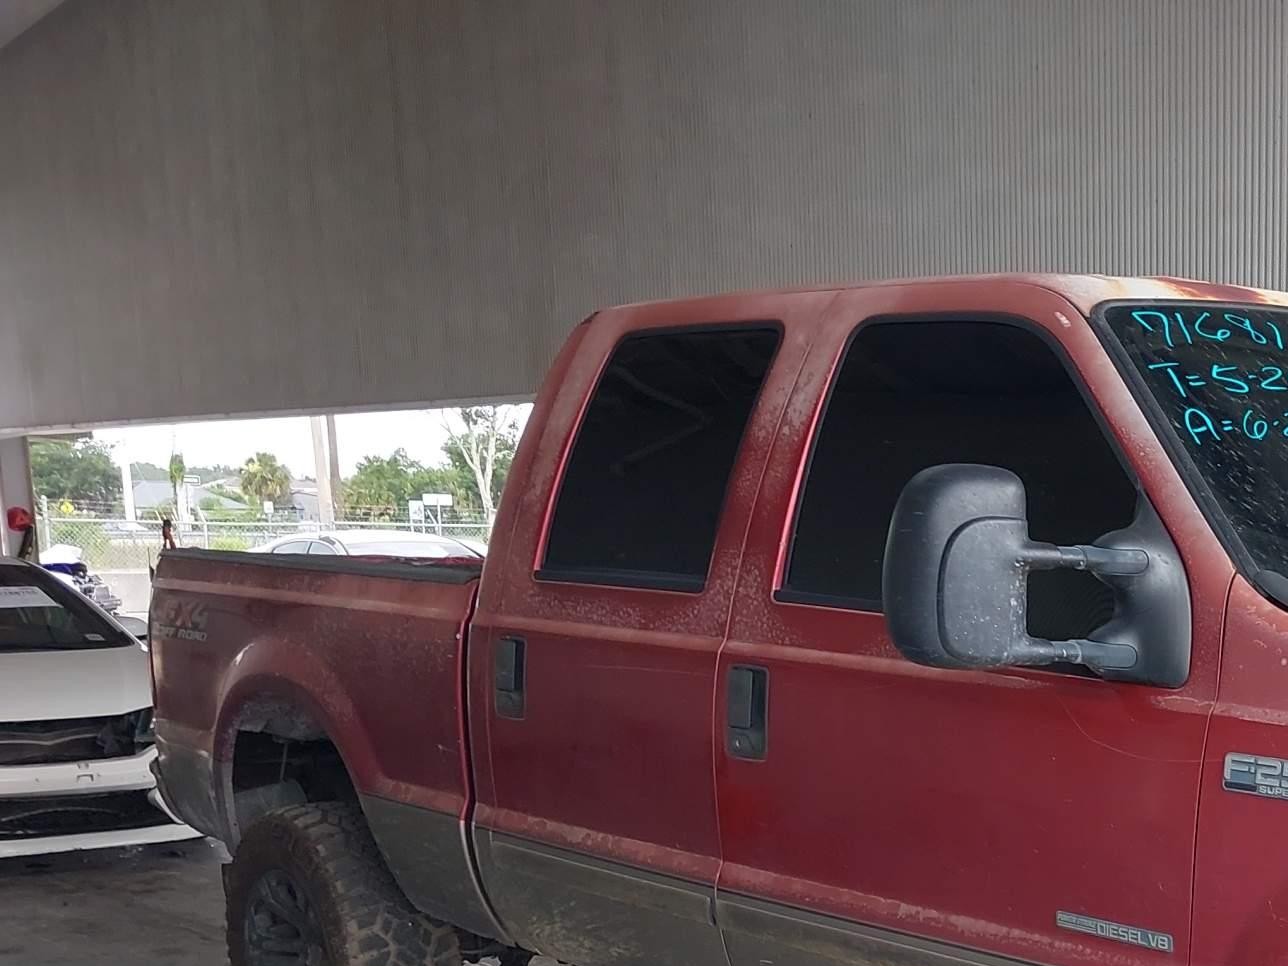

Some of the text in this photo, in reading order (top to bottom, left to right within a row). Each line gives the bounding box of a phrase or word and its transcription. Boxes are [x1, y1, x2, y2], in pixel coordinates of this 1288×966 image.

[1131, 311, 1284, 350] 71681
[1096, 922, 1169, 950] DIESEL V8
